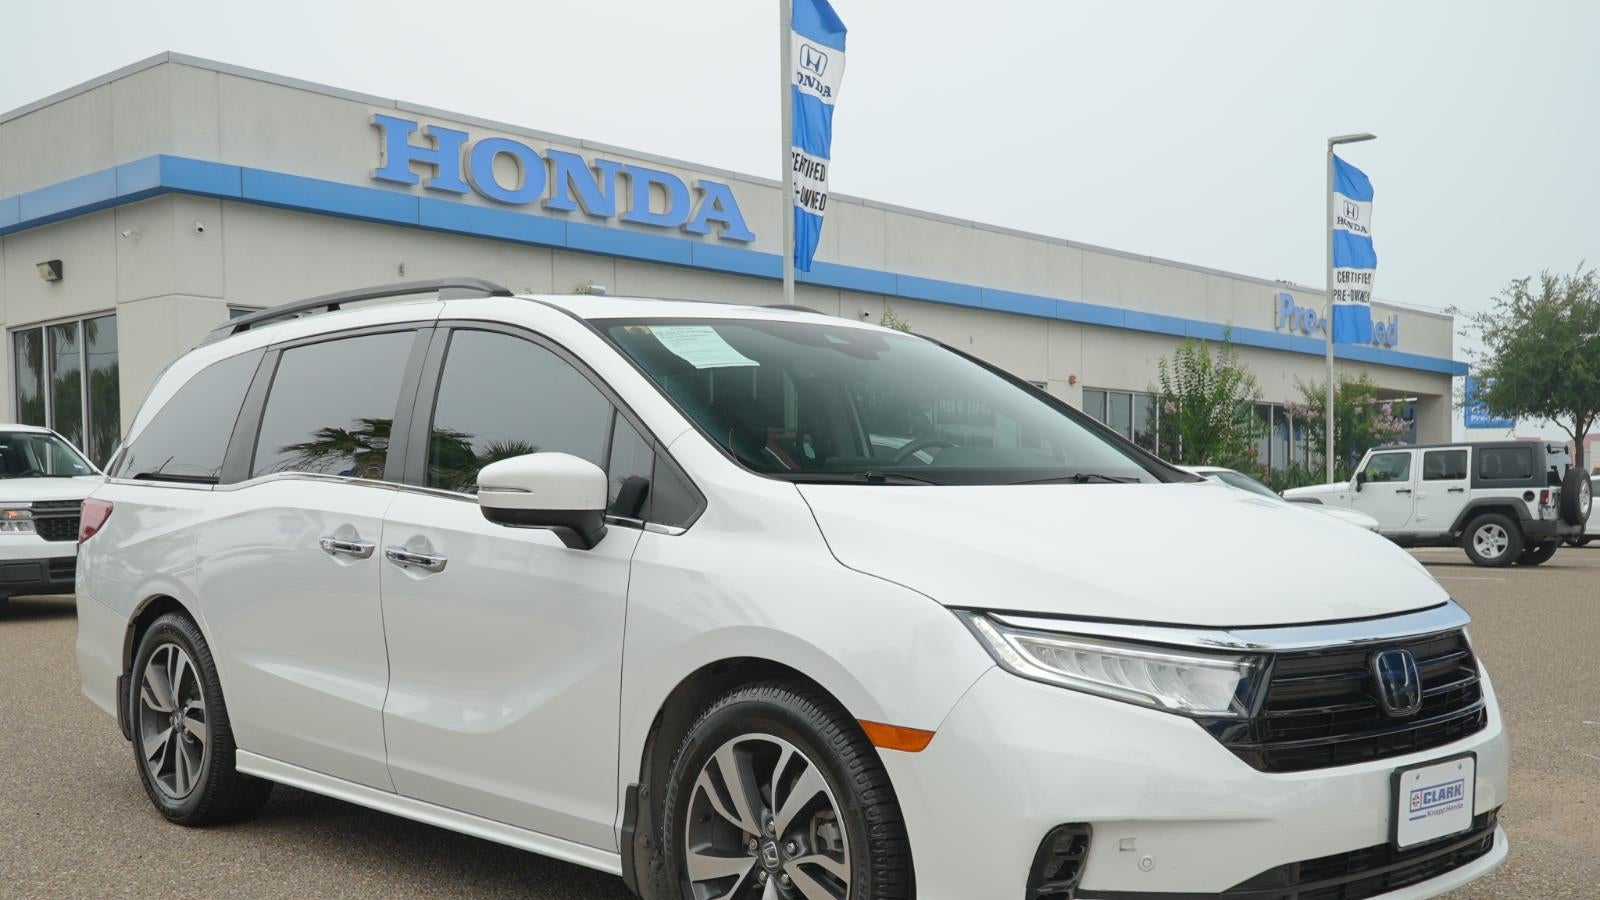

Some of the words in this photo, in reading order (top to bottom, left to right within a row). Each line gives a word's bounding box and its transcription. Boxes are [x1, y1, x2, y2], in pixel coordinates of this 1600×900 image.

[797, 72, 832, 98] ONDA
[370, 113, 756, 243] HONDA
[792, 152, 826, 182] ERTIFIED
[1337, 216, 1367, 233] HONDA
[1423, 784, 1462, 804] CLARK
